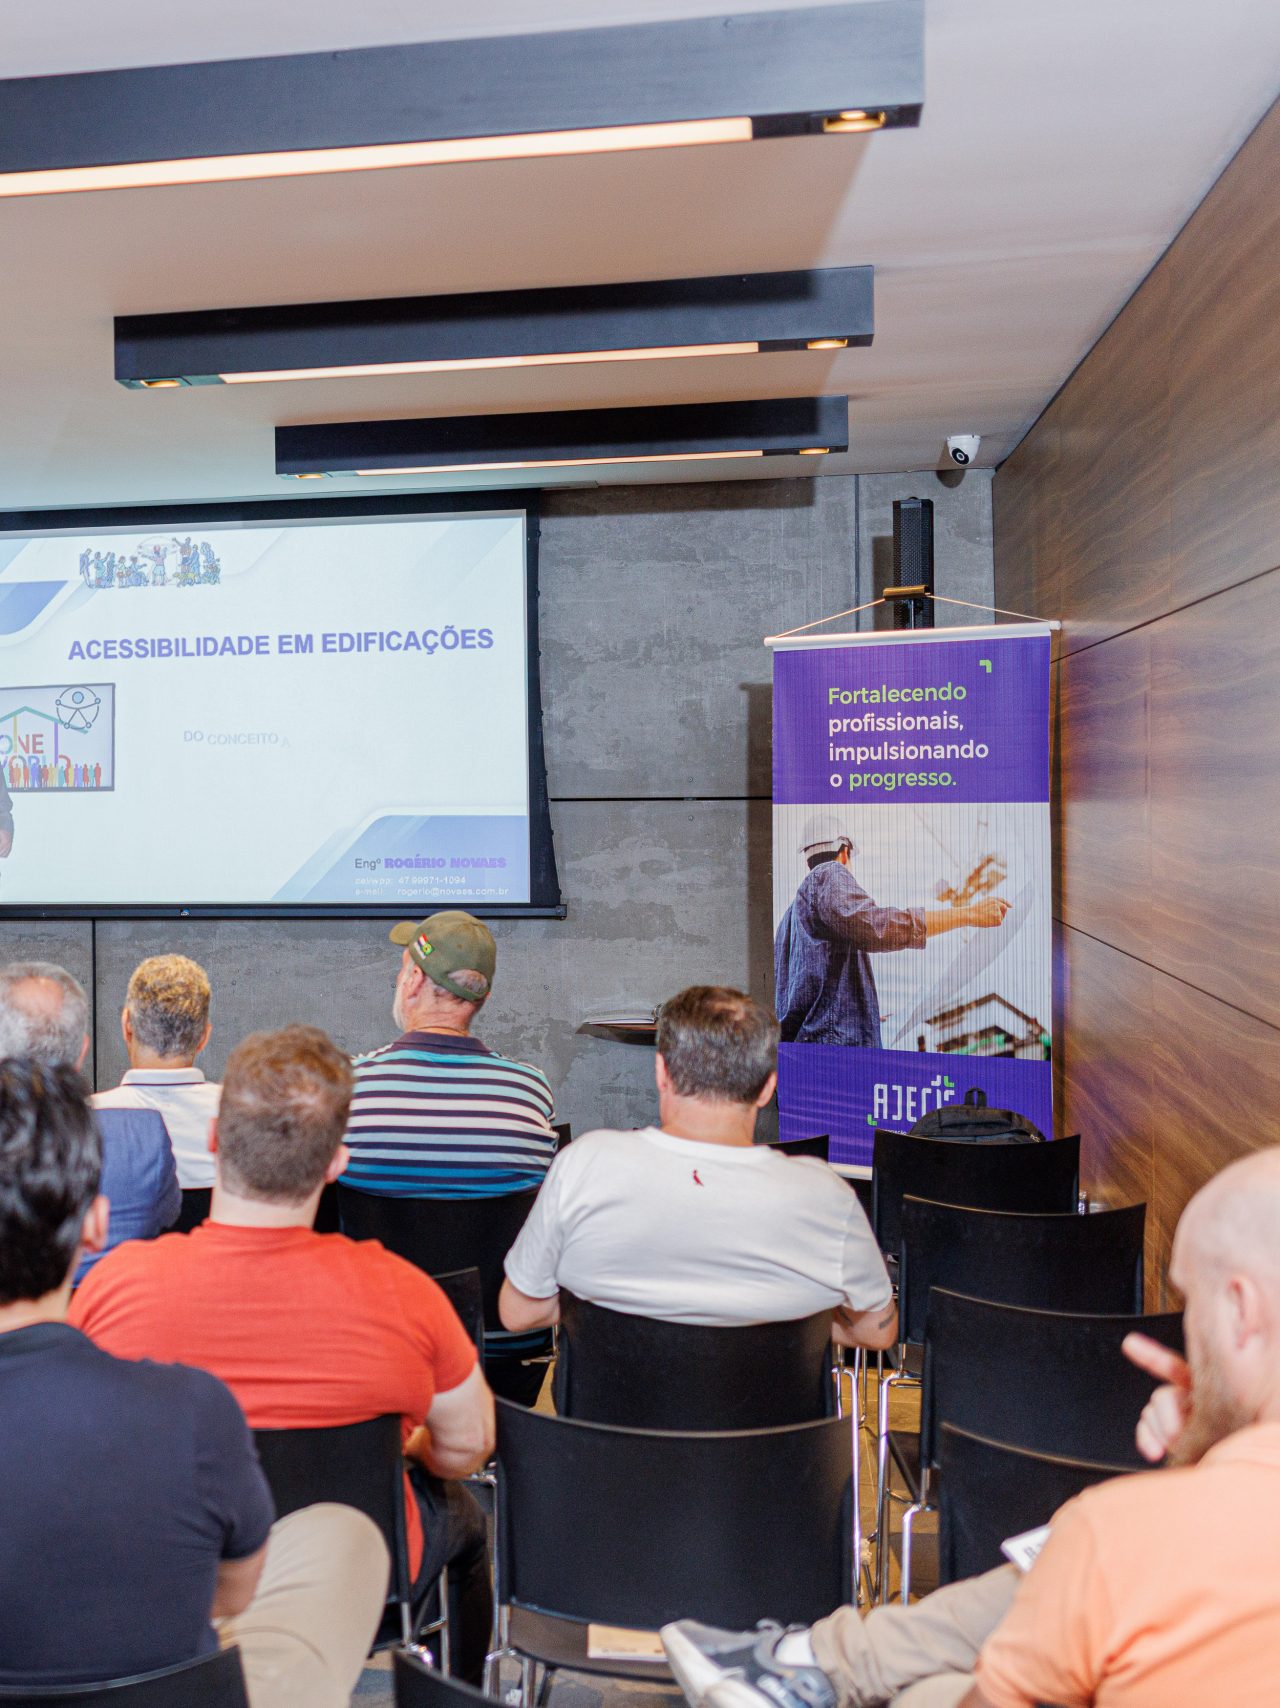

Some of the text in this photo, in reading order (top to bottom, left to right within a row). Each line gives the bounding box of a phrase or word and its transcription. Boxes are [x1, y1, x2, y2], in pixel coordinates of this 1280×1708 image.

[67, 625, 495, 661] ACESSIBILIDADE EM EDIFICAÇÕES
[828, 681, 967, 705] Fortalecendo
[828, 710, 964, 737] profissionais,
[183, 730, 204, 742] DO
[207, 732, 279, 745] CONCEITO
[829, 739, 989, 765] impulsionando
[829, 771, 957, 791] o progresso.
[384, 854, 446, 869] ROGÉRIO
[450, 857, 507, 869] NOVAES
